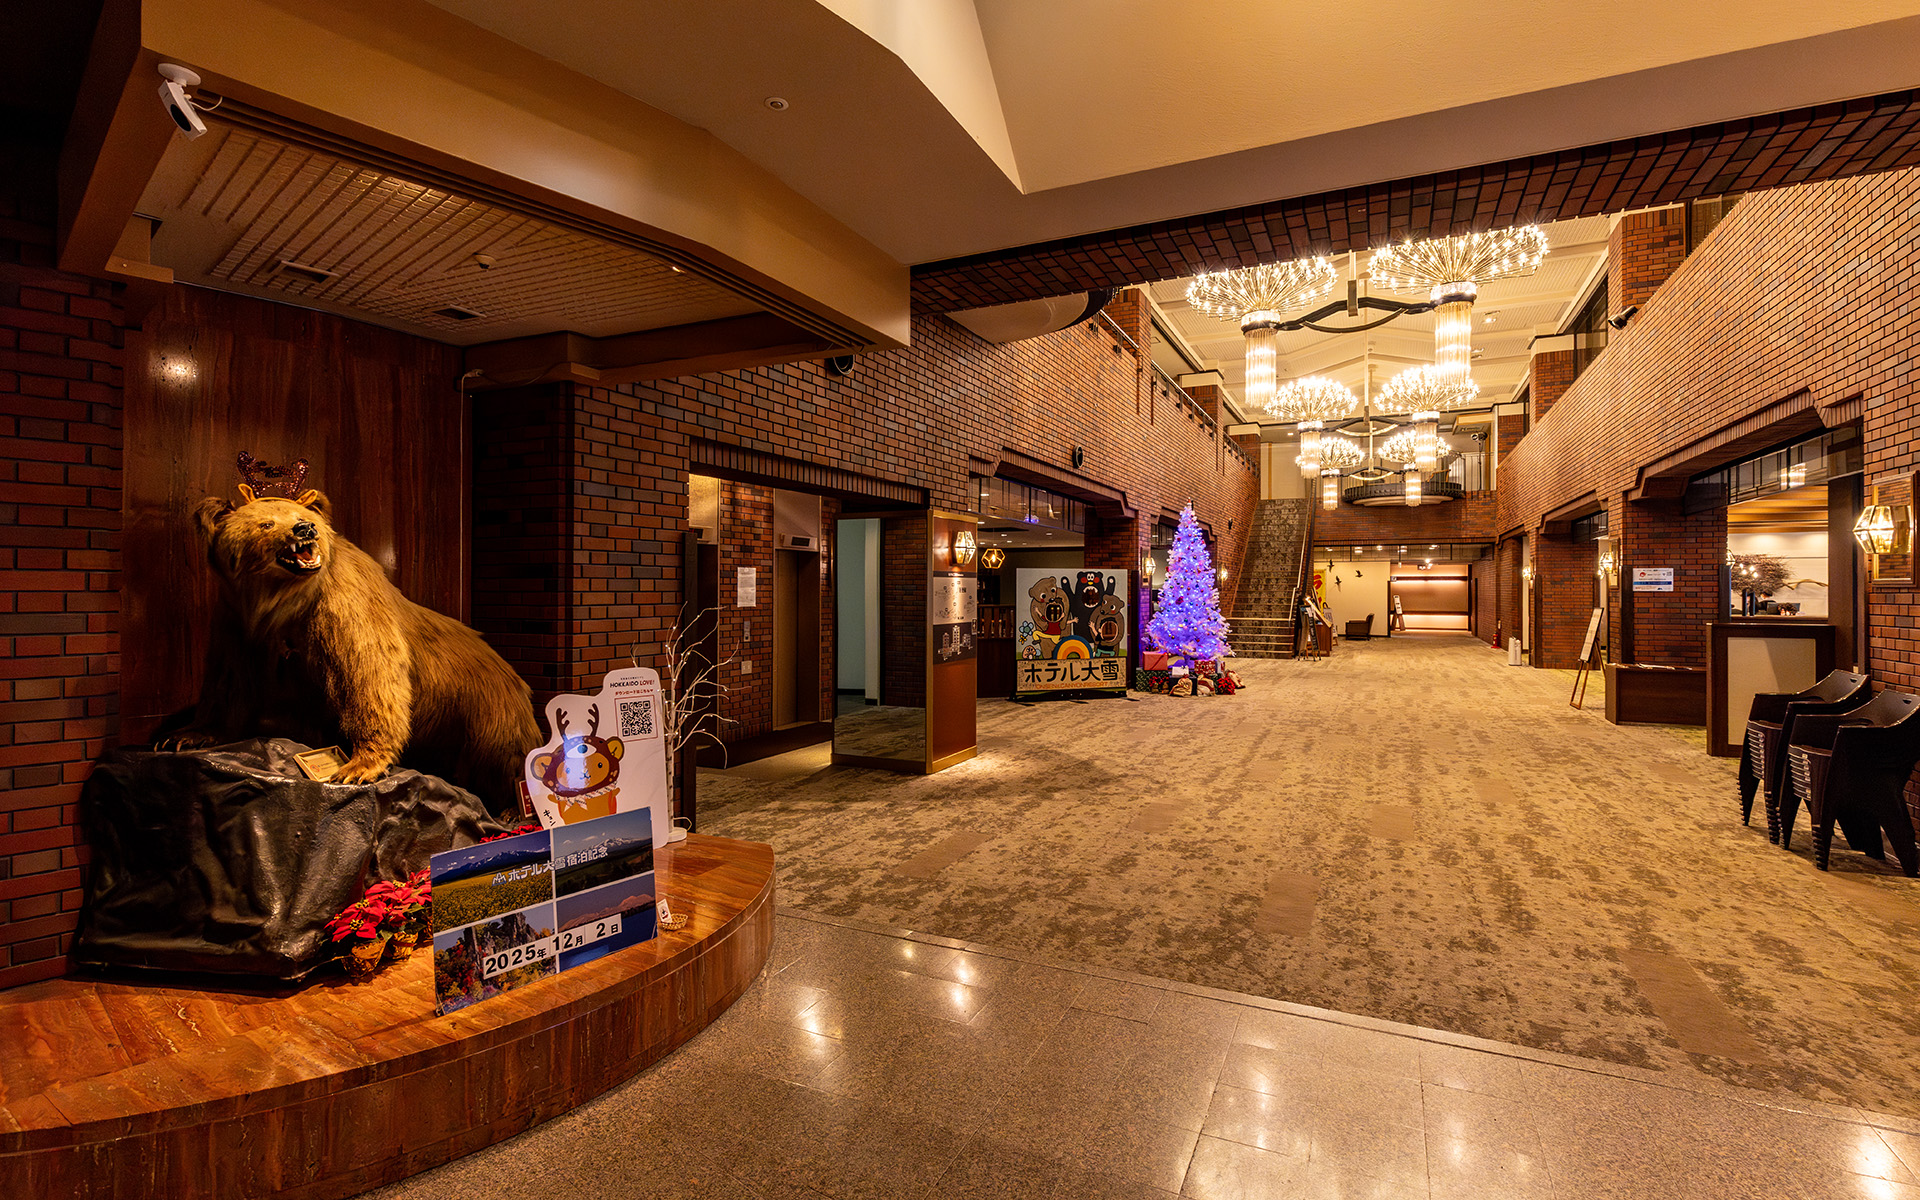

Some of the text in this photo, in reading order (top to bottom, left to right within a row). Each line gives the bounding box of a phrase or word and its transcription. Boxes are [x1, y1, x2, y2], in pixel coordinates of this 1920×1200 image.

[1024, 660, 1119, 682] ホテル大雪
[485, 944, 547, 975] 2025年
